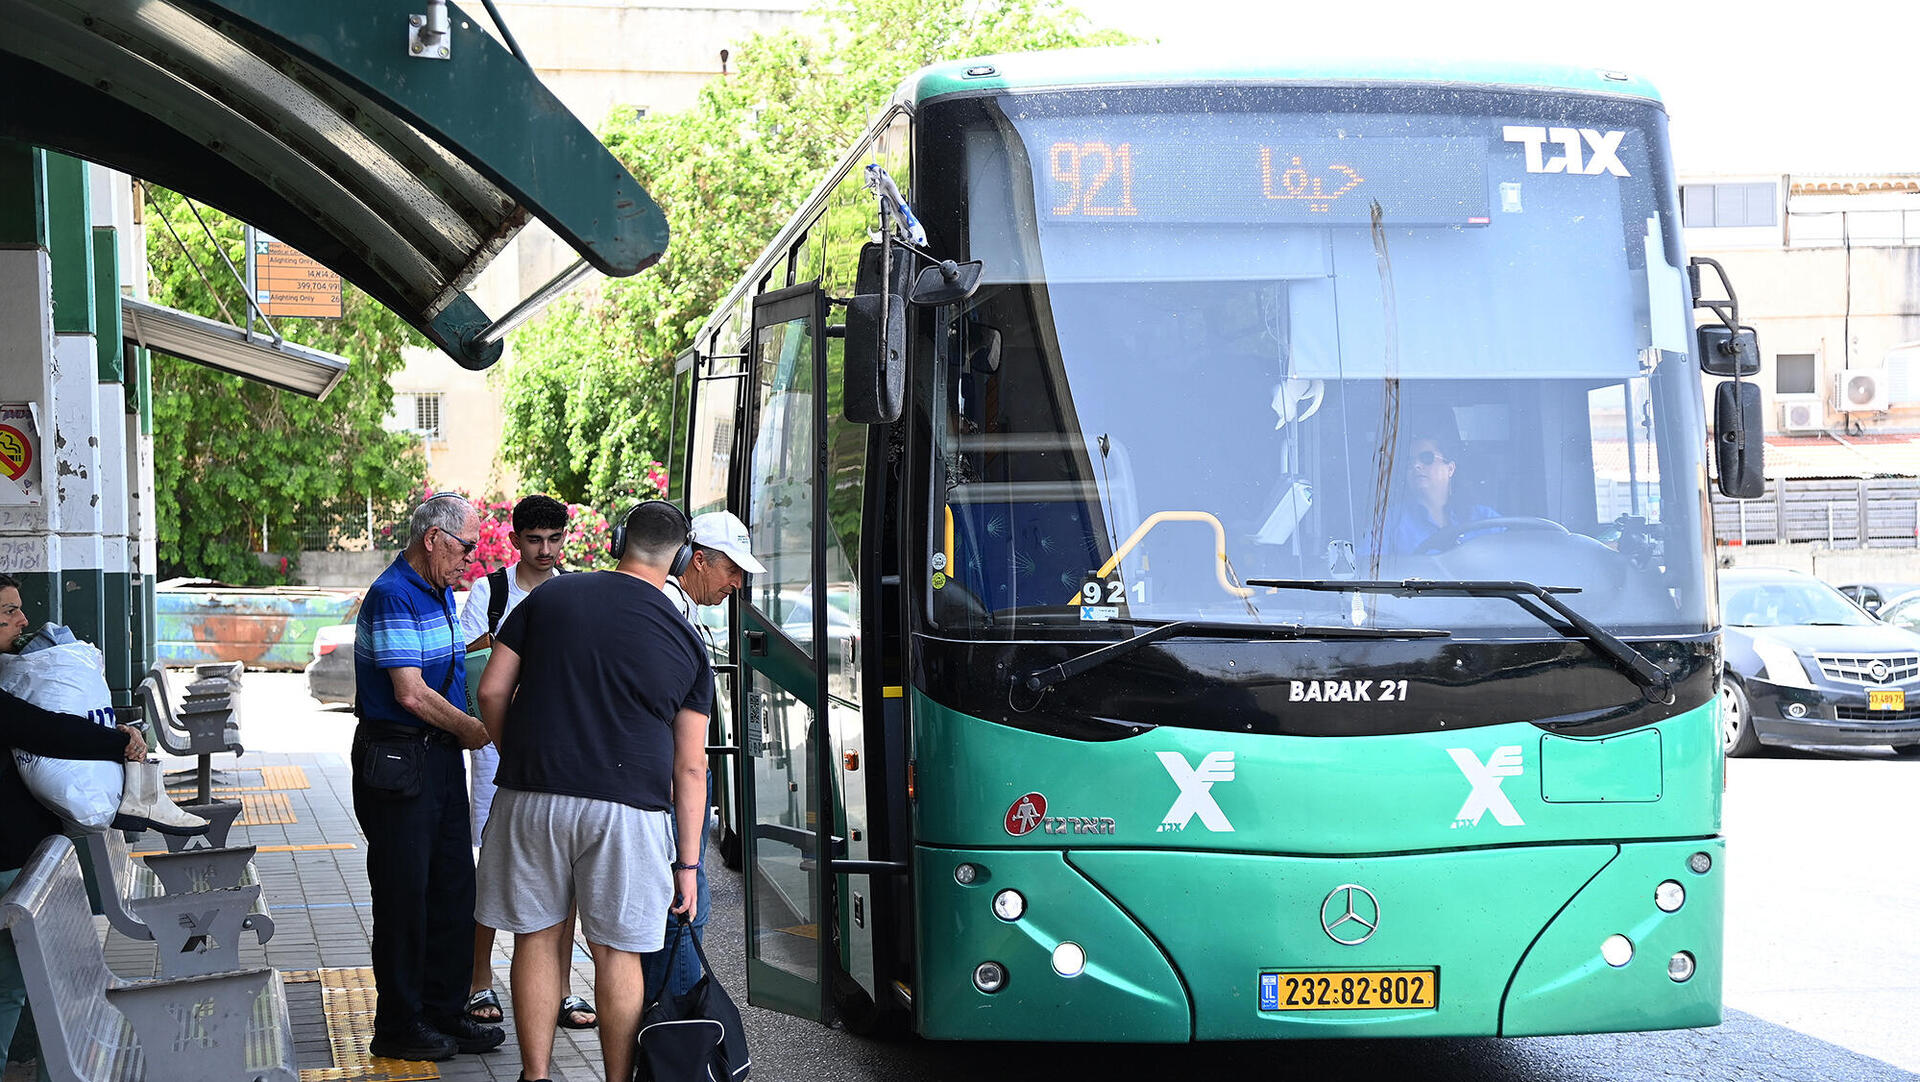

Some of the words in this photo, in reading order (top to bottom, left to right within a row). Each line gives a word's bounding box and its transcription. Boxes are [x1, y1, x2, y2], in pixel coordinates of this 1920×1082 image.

[1502, 126, 1632, 178] אגד
[1050, 141, 1138, 216] 921
[1258, 147, 1366, 213] حيفا
[270, 257, 297, 265] Alighting
[270, 294, 298, 302] Alighting
[299, 295, 315, 303] Only
[1082, 581, 1145, 604] 921
[1288, 680, 1374, 702] BARAK
[1377, 680, 1409, 702] 21
[1044, 816, 1116, 835] הארגז
